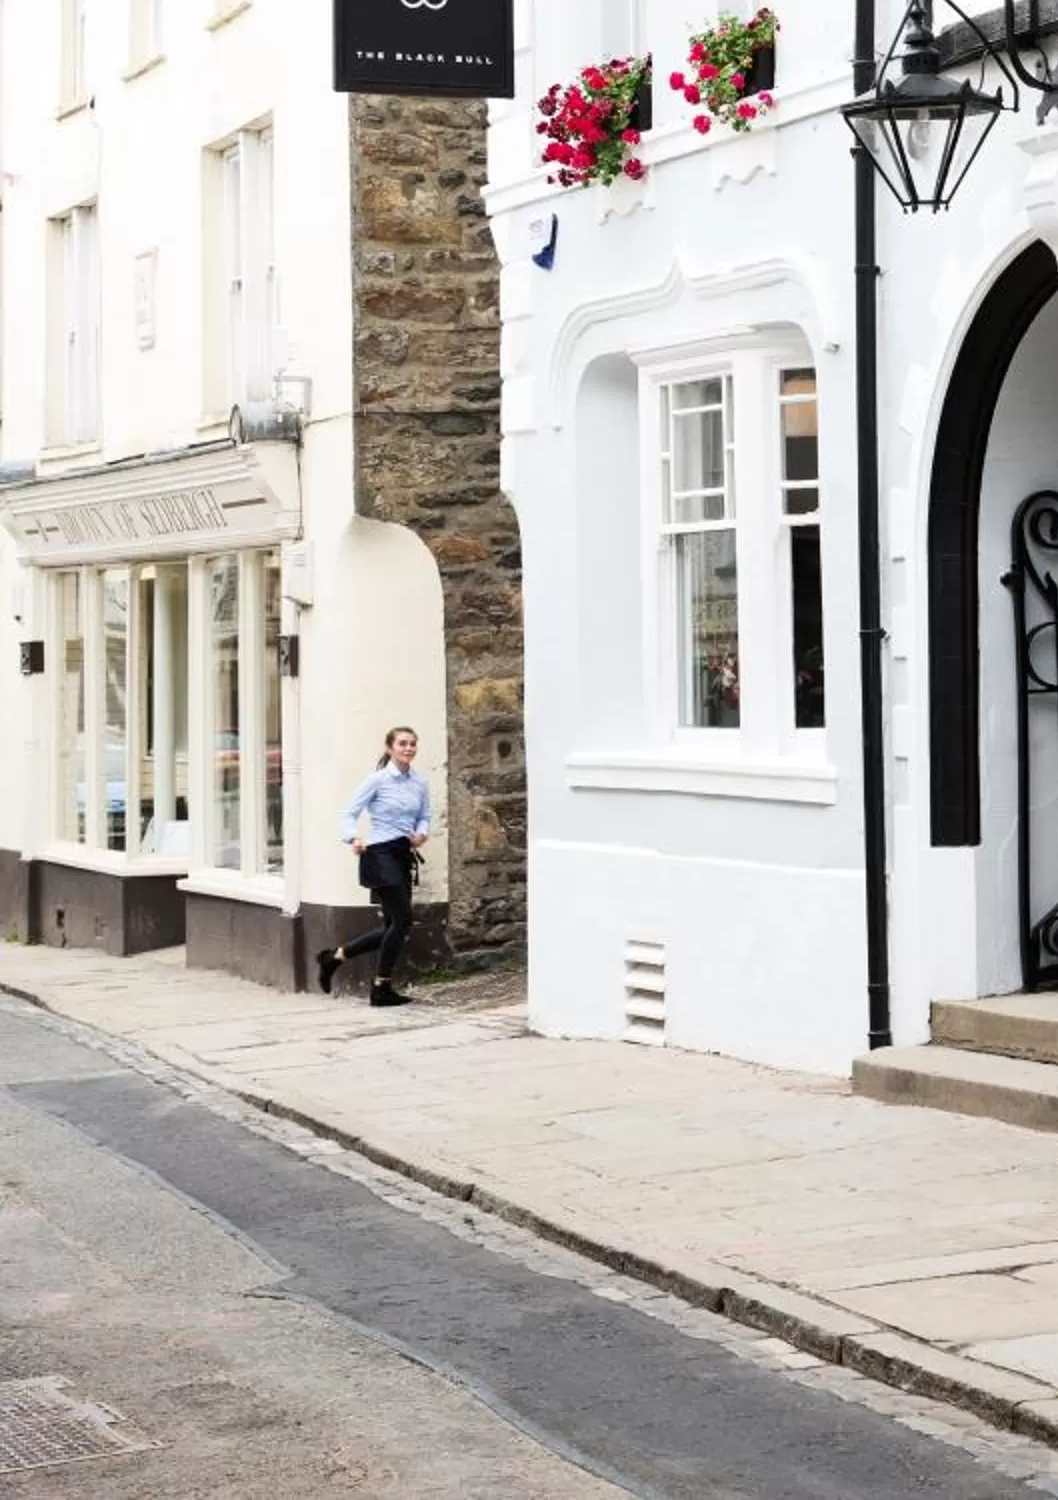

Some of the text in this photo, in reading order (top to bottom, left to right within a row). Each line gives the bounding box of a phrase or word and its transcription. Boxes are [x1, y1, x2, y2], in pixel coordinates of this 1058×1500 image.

[356, 50, 493, 65] THE BLACK BULL
